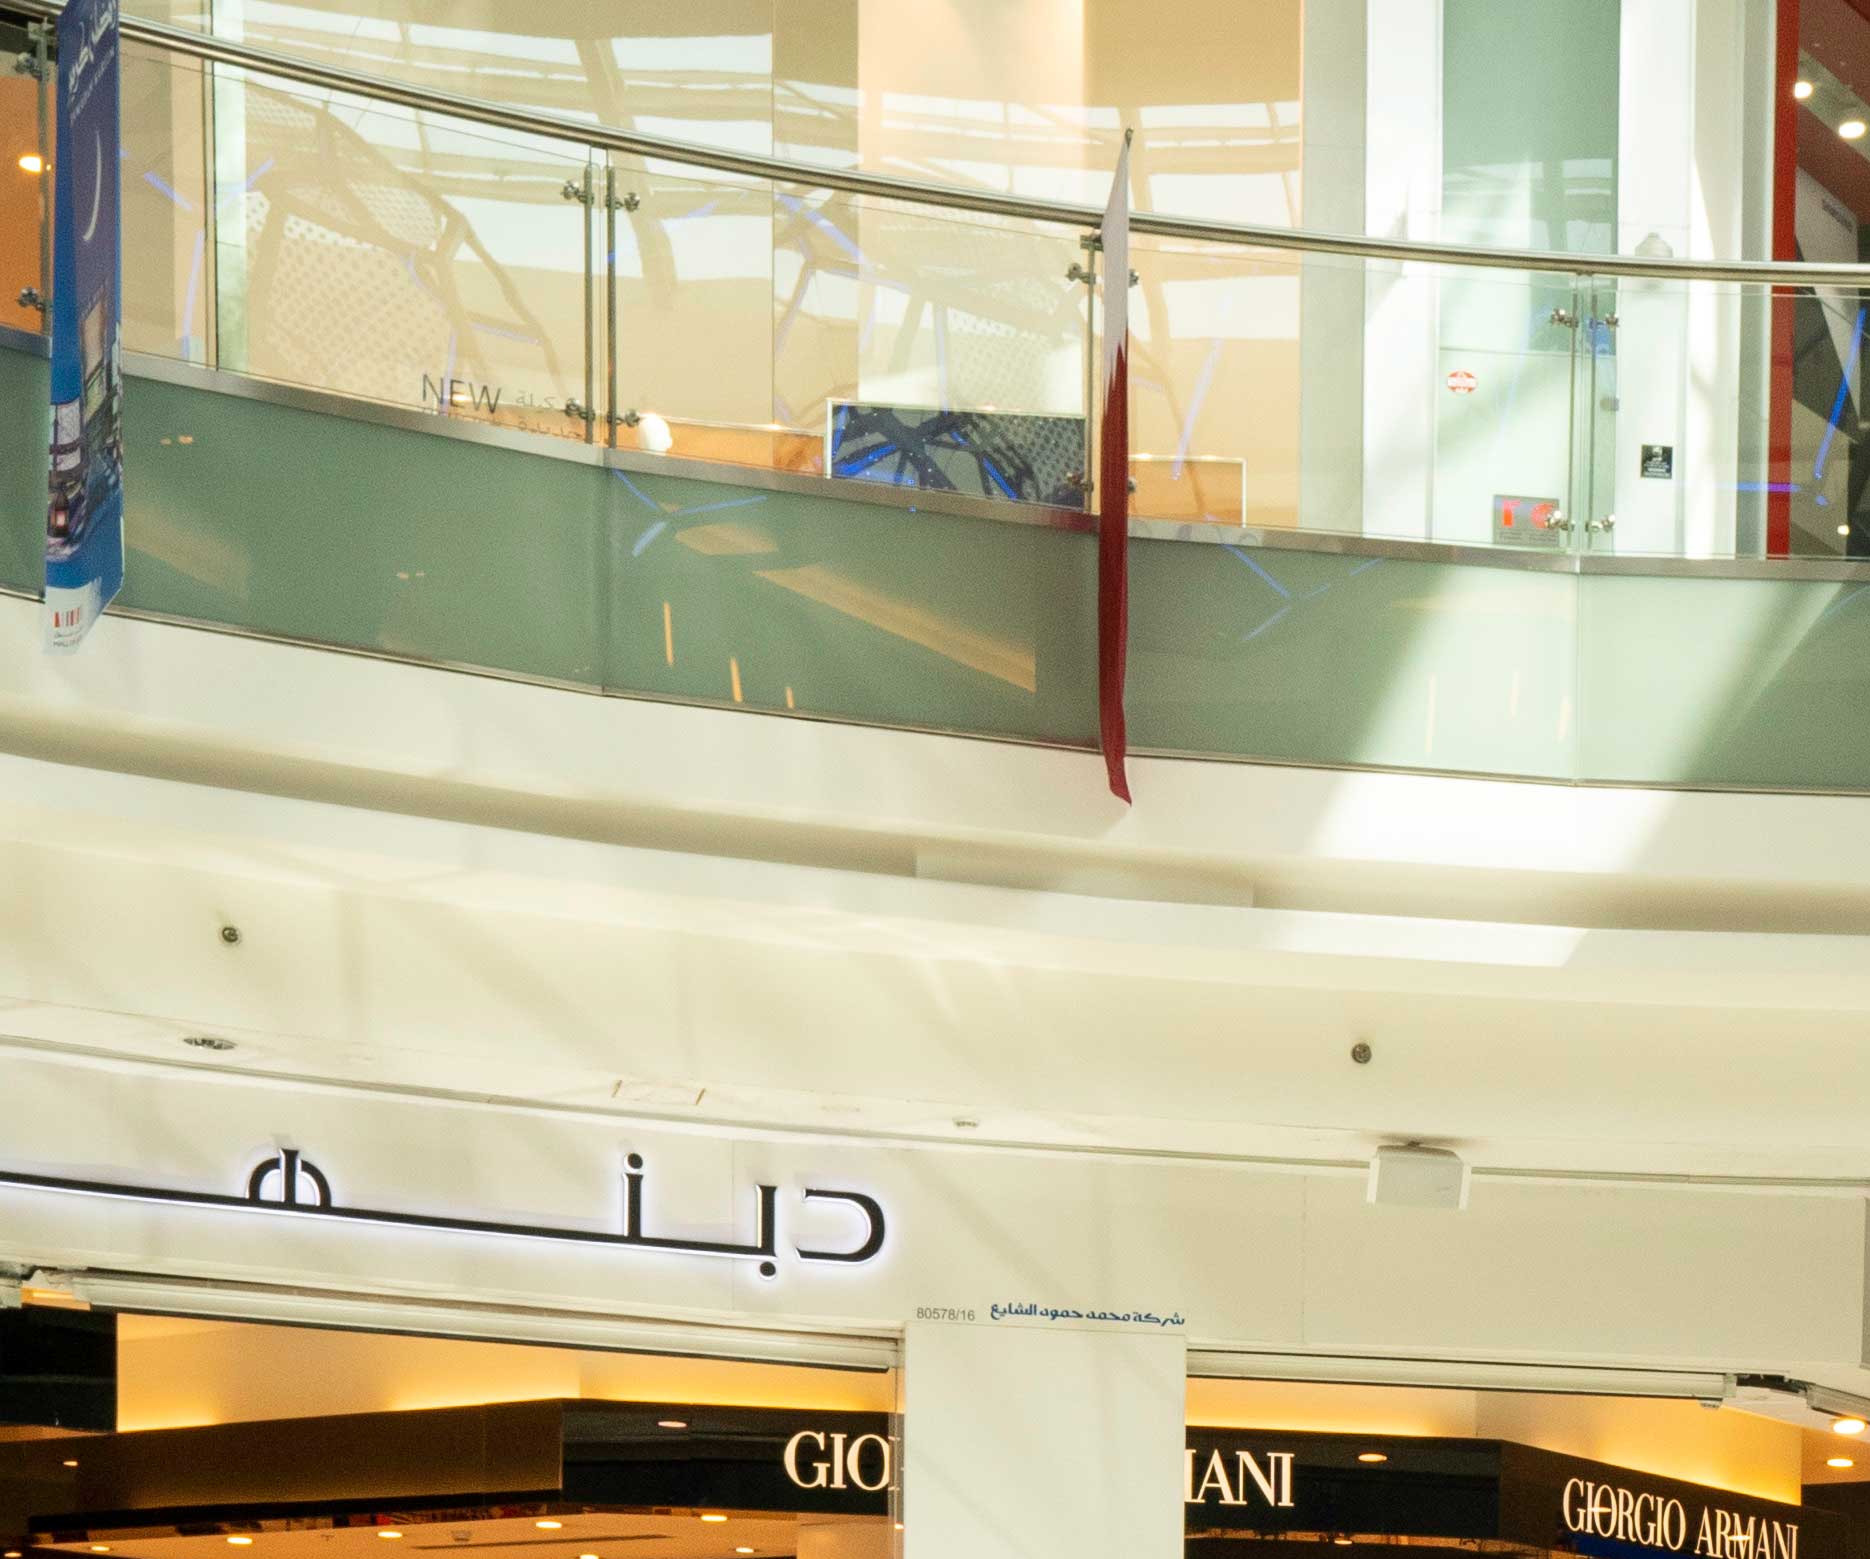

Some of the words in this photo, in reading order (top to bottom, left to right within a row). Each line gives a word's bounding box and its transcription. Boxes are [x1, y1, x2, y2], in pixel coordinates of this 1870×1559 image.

[422, 373, 503, 415] NEW
[916, 1307, 976, 1321] 80578/16
[990, 1302, 1038, 1320] الشايع
[1040, 1308, 1084, 1321] حمود
[1086, 1310, 1131, 1322] محمد
[1133, 1311, 1185, 1327] شركة
[1562, 1478, 1687, 1551] GIORGIO
